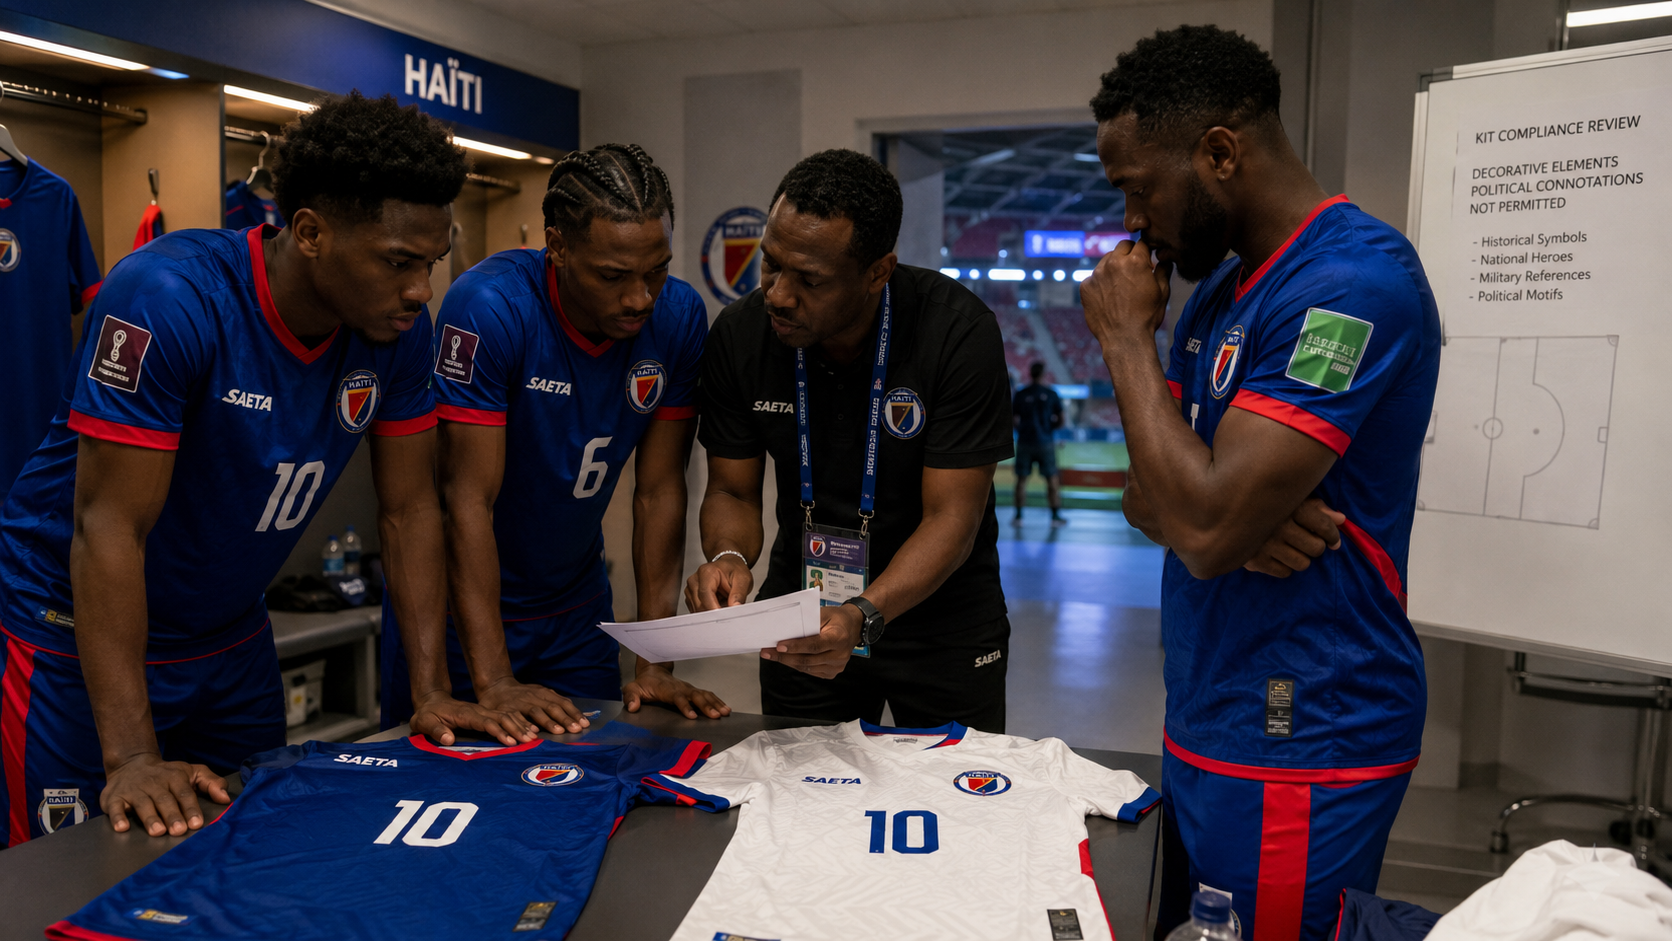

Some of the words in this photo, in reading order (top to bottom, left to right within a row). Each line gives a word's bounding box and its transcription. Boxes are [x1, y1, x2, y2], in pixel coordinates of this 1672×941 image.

[404, 53, 483, 115] HAÏTI
[1475, 130, 1496, 144] KIT
[1498, 121, 1584, 142] COMPLIANCE
[1587, 115, 1642, 133] REVIEW
[1472, 161, 1549, 180] DECORATIVE
[1551, 155, 1619, 173] ELEMENTS
[1471, 181, 1533, 197] POLITICAL
[1536, 172, 1644, 193] CONNOTATIONS
[1469, 201, 1496, 215] NOT
[1498, 196, 1567, 213] PERMITTED
[1481, 233, 1535, 248] Historical
[1537, 230, 1588, 248] Symbols
[1480, 252, 1528, 266] National
[1531, 251, 1574, 264] Heroes
[1479, 271, 1522, 286] Military
[1525, 269, 1592, 282] References
[1478, 289, 1523, 302] Political
[1526, 288, 1564, 301] Motifs
[525, 376, 572, 396] SAETA
[222, 388, 273, 412] SAETA
[752, 401, 794, 414] SAETA
[572, 436, 613, 499] 6
[254, 460, 326, 533] 10
[974, 649, 1002, 668] SAETA
[333, 753, 398, 768] SAETA
[801, 776, 862, 785] SAETA
[373, 800, 480, 848] 10
[864, 810, 940, 855] 10
